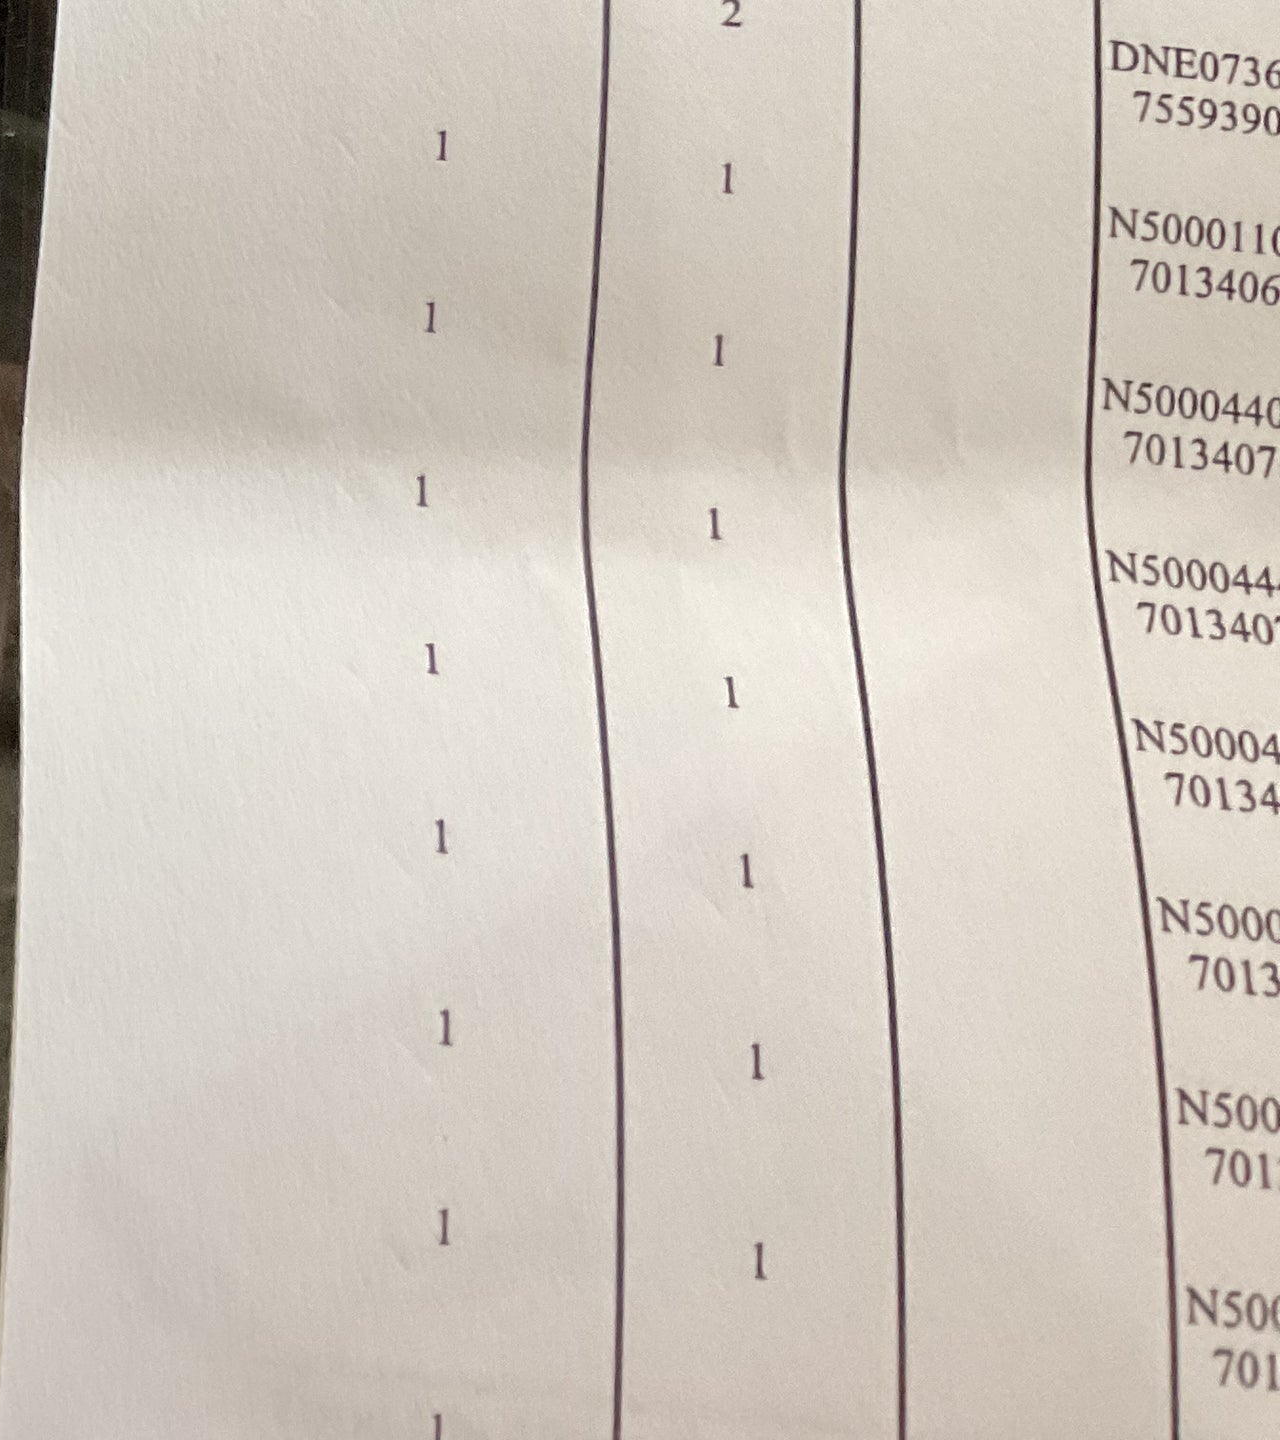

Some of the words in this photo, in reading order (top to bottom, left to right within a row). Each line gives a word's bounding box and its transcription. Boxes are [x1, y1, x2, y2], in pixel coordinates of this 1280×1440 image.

[435, 129, 448, 162] 1
[721, 161, 735, 195] 1
[424, 301, 437, 335] 1
[712, 333, 725, 367] 1
[416, 473, 429, 508] 1
[708, 507, 723, 542] 1
[1104, 549, 1280, 599] N500044
[1136, 601, 1280, 646] 701340
[424, 642, 440, 676] 1
[722, 675, 741, 710] 1
[434, 818, 449, 855] 1
[739, 852, 755, 890] 1
[438, 1008, 454, 1048] 1
[750, 1041, 766, 1082] 1
[1205, 1146, 1280, 1190] 701
[438, 1207, 451, 1247] 1
[753, 1241, 768, 1281] 1
